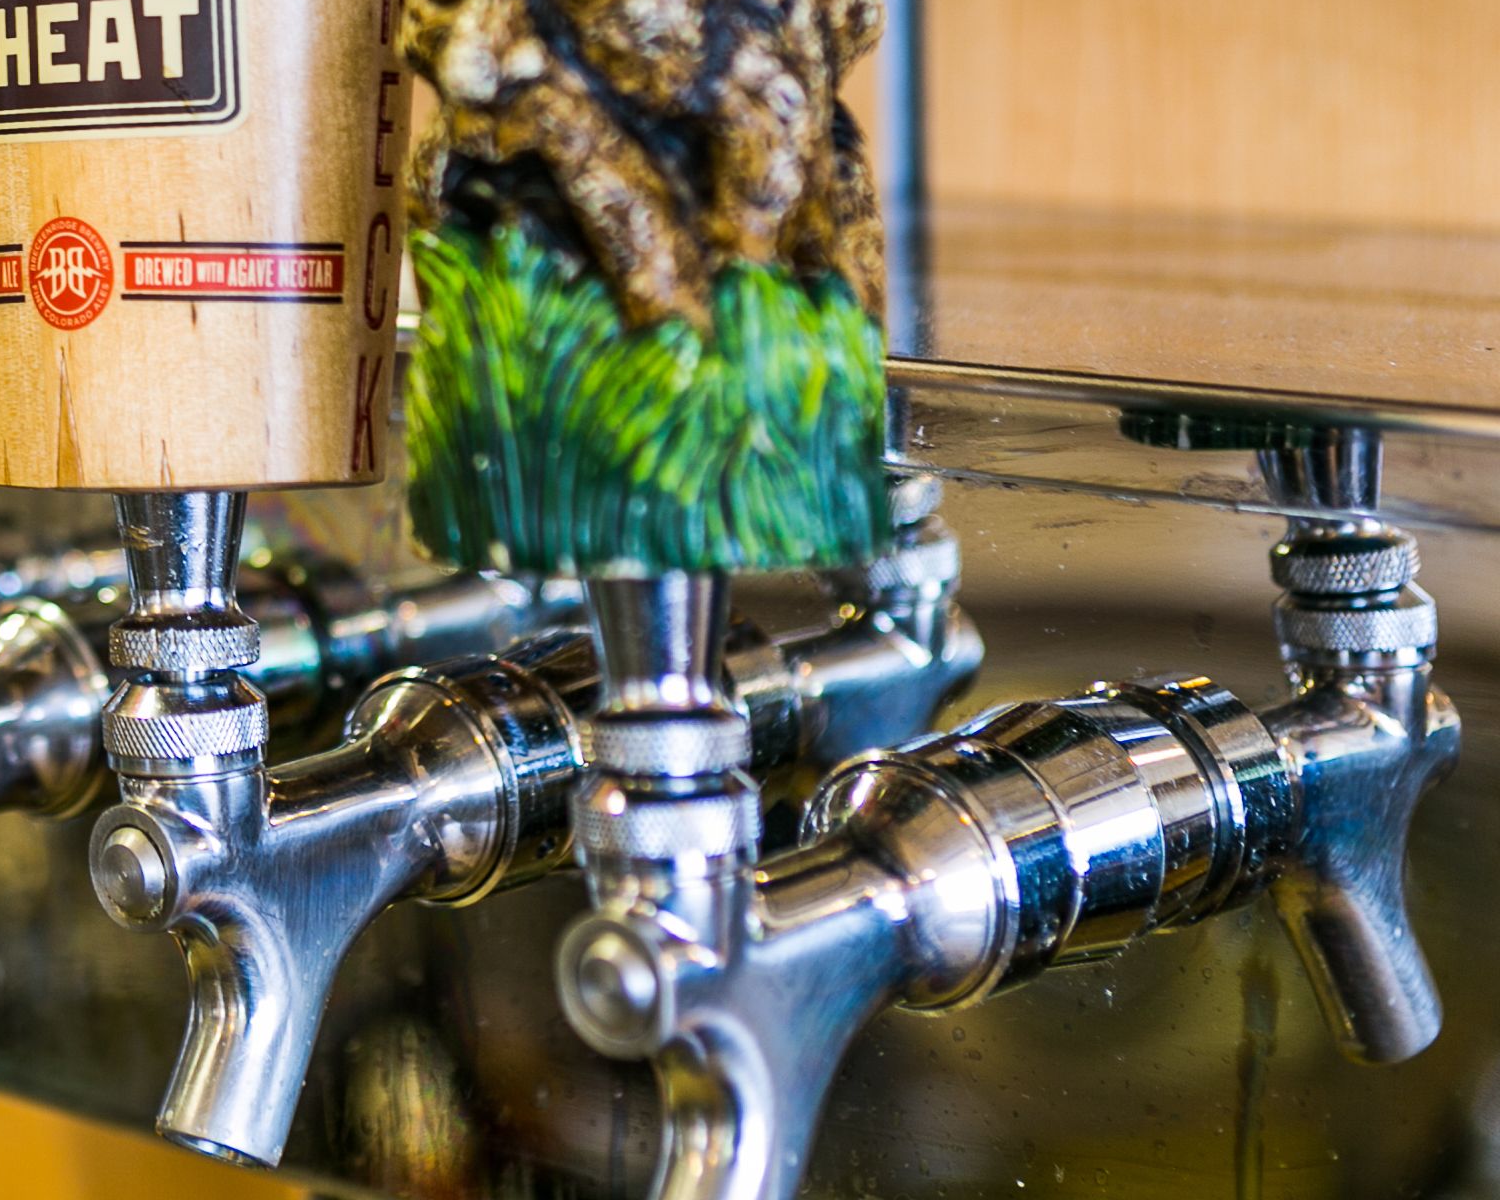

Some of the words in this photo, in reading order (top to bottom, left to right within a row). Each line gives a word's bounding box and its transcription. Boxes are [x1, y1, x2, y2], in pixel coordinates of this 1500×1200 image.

[30, 220, 77, 271] BRECKENRIDGE
[79, 224, 111, 271] BREWERY
[2, 260, 19, 288] ALE
[134, 257, 193, 287] BREWED
[227, 257, 275, 288] AGAVE
[277, 259, 334, 288] NECTAR
[31, 284, 46, 310] FINE
[44, 308, 94, 327] COLORADO
[94, 282, 111, 311] ALES
